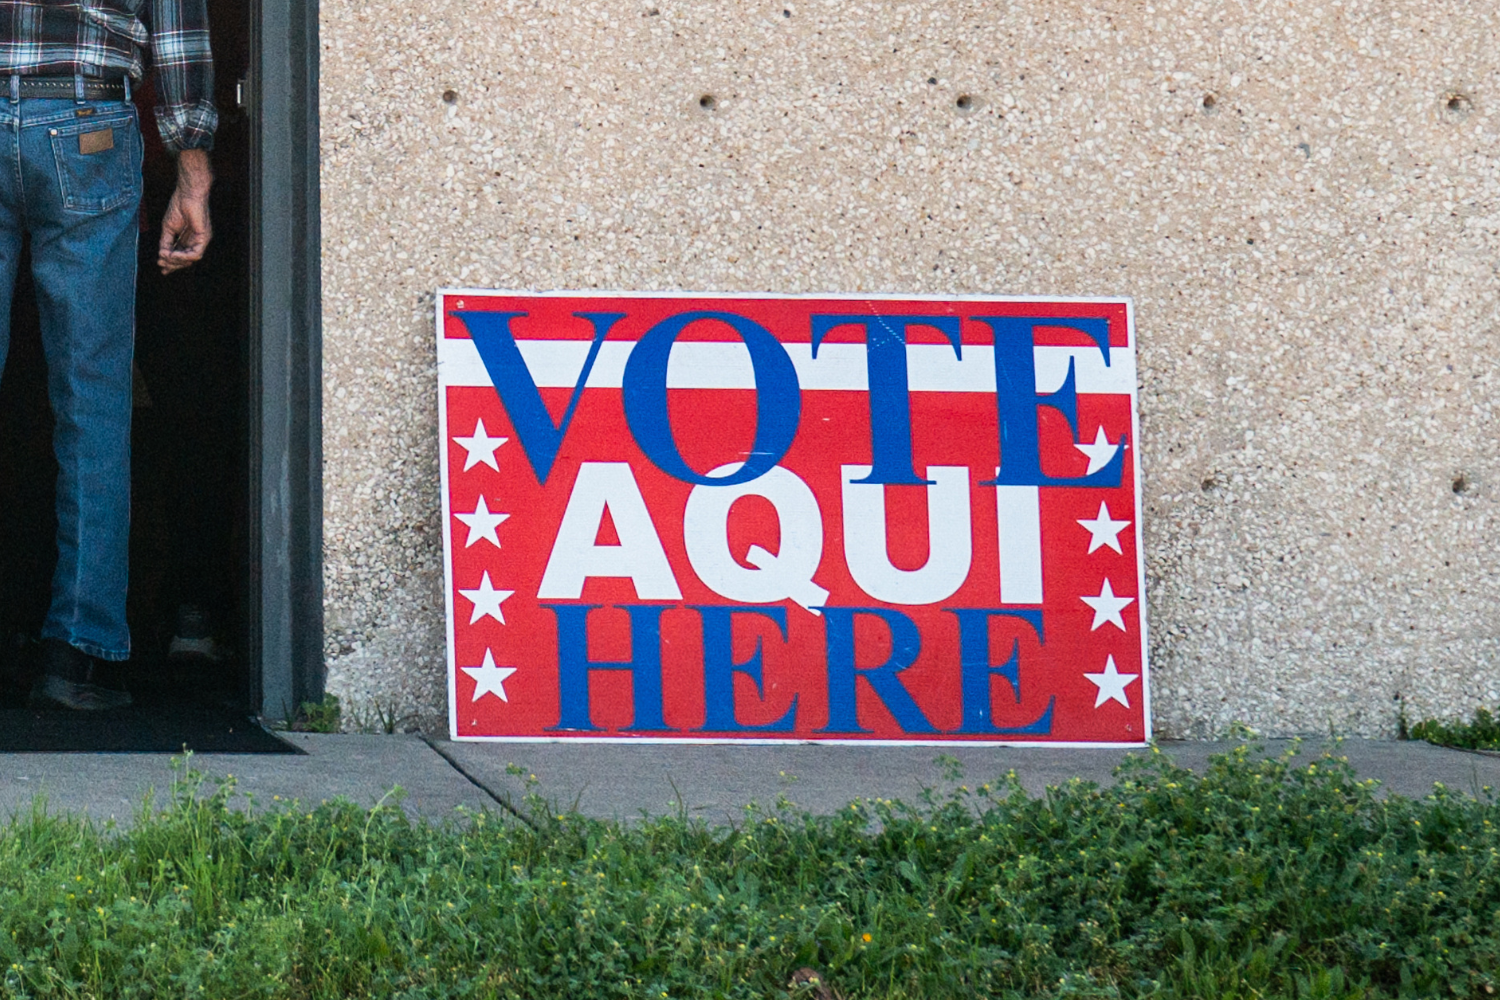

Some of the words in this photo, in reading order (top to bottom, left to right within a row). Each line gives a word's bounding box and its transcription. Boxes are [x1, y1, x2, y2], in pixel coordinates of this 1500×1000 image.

[449, 310, 1127, 488] VOTE
[536, 461, 1043, 617] AQUI
[539, 603, 1056, 736] HERE
